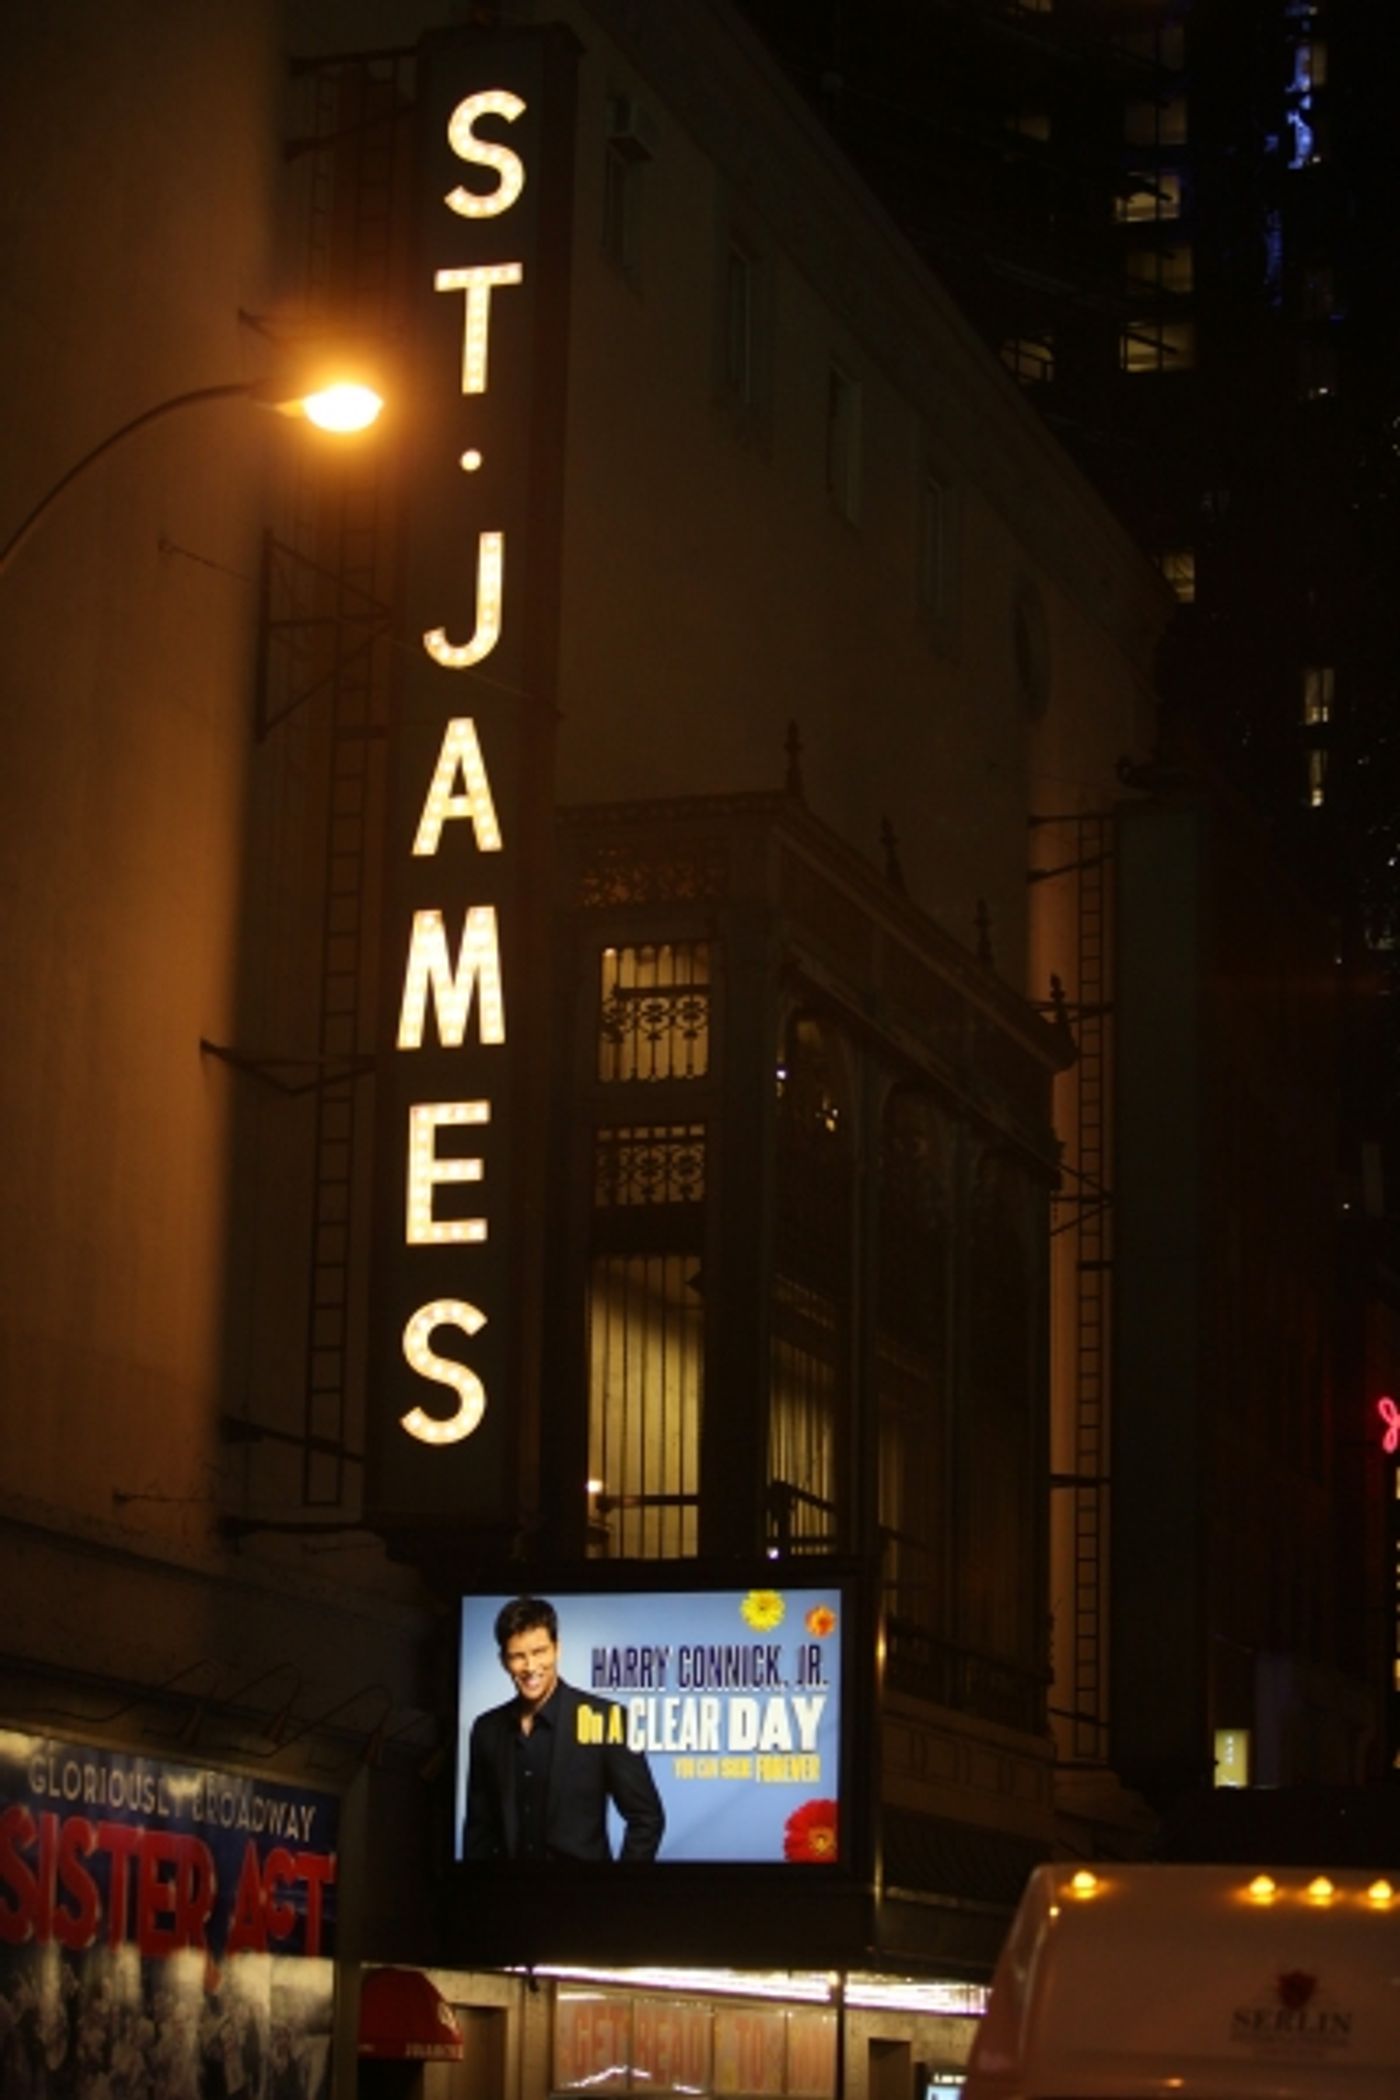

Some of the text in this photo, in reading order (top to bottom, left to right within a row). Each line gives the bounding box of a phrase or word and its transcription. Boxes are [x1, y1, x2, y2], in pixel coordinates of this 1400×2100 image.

[398, 530, 506, 1445] JAMES
[591, 1647, 669, 1689] HARRY
[797, 1644, 829, 1686] JR.
[608, 1704, 624, 1744] A
[627, 1697, 721, 1754] CLEAR
[729, 1695, 827, 1752] DAY
[192, 1778, 318, 1844] BROADWAY
[0, 1804, 338, 1965] SISTER ACT
